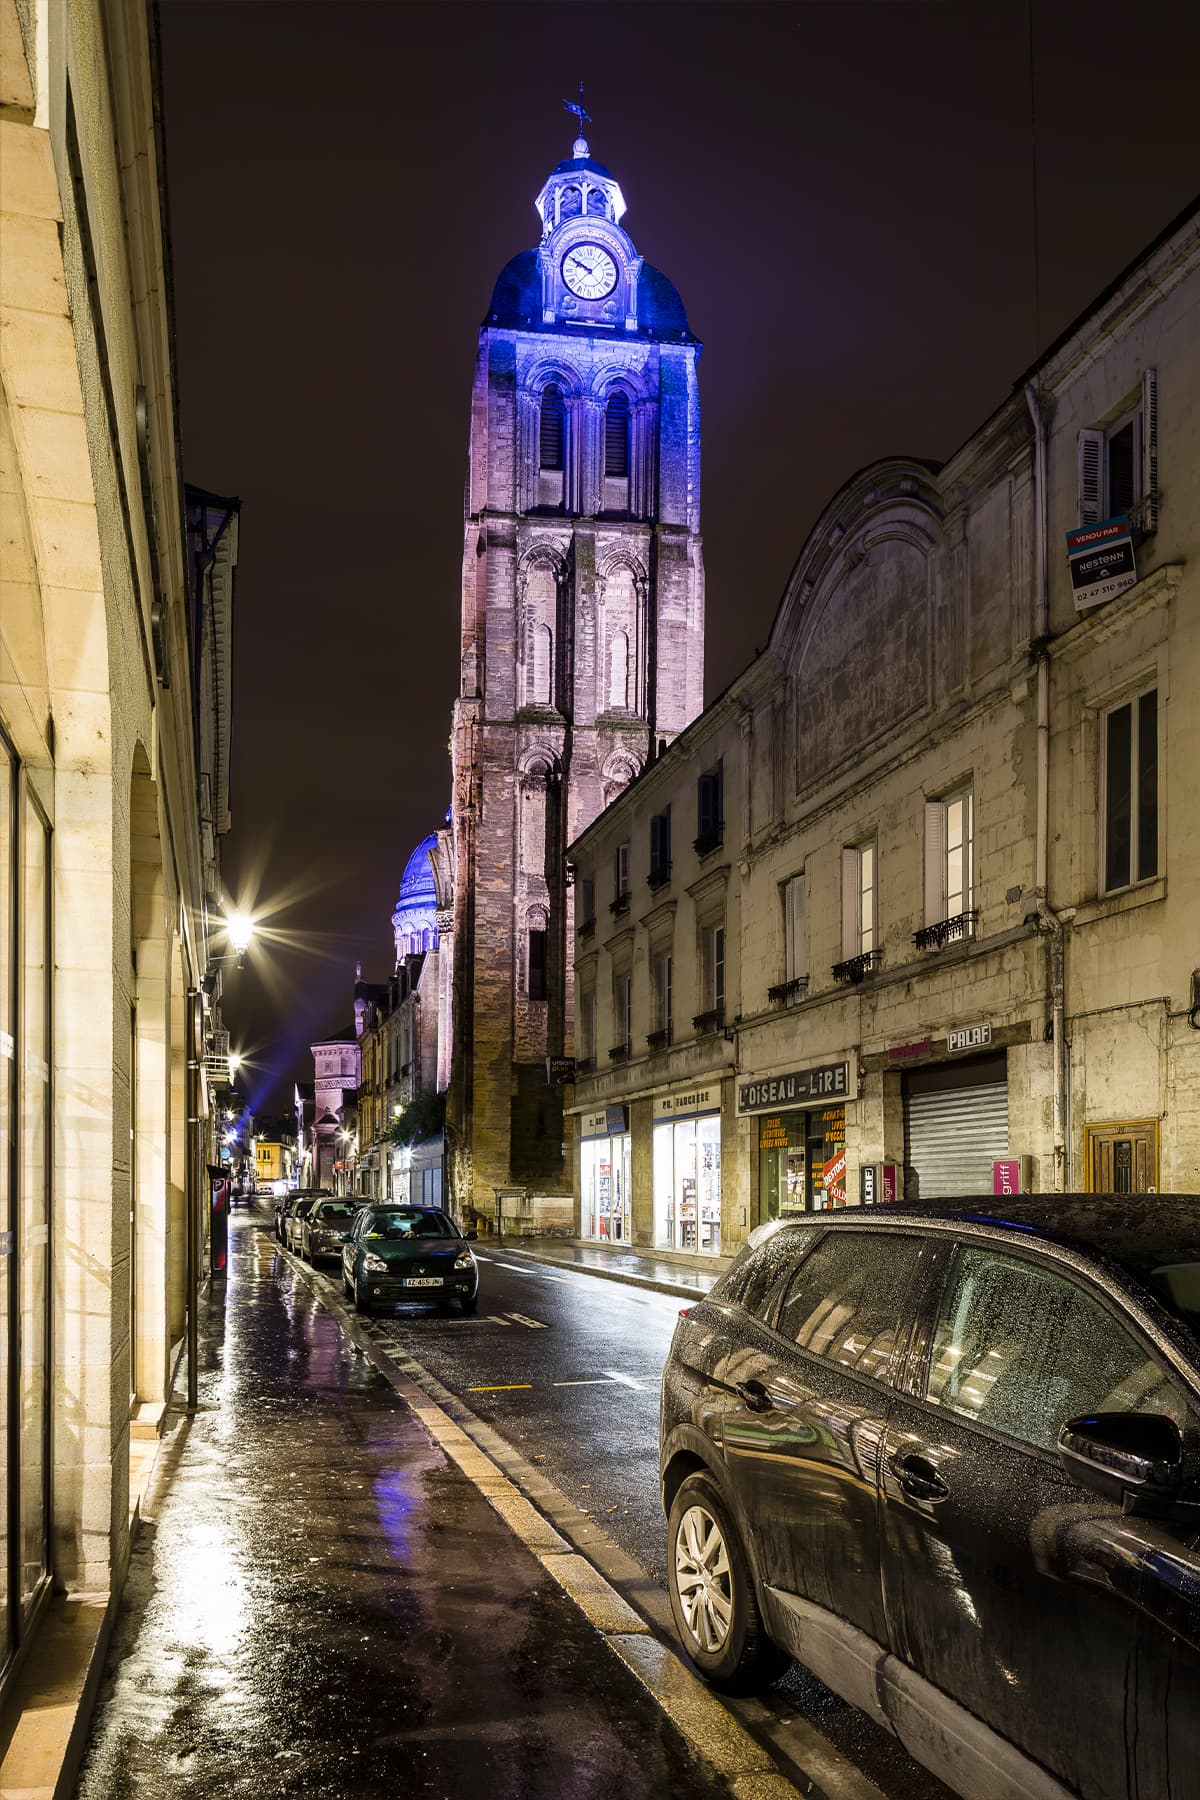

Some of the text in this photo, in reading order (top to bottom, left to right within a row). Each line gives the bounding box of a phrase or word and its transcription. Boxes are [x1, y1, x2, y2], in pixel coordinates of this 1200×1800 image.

[1076, 526, 1119, 543] VENDU PAR
[1077, 592, 1088, 601] 02
[949, 1025, 988, 1050] PALAF
[1000, 1164, 1012, 1195] griff
